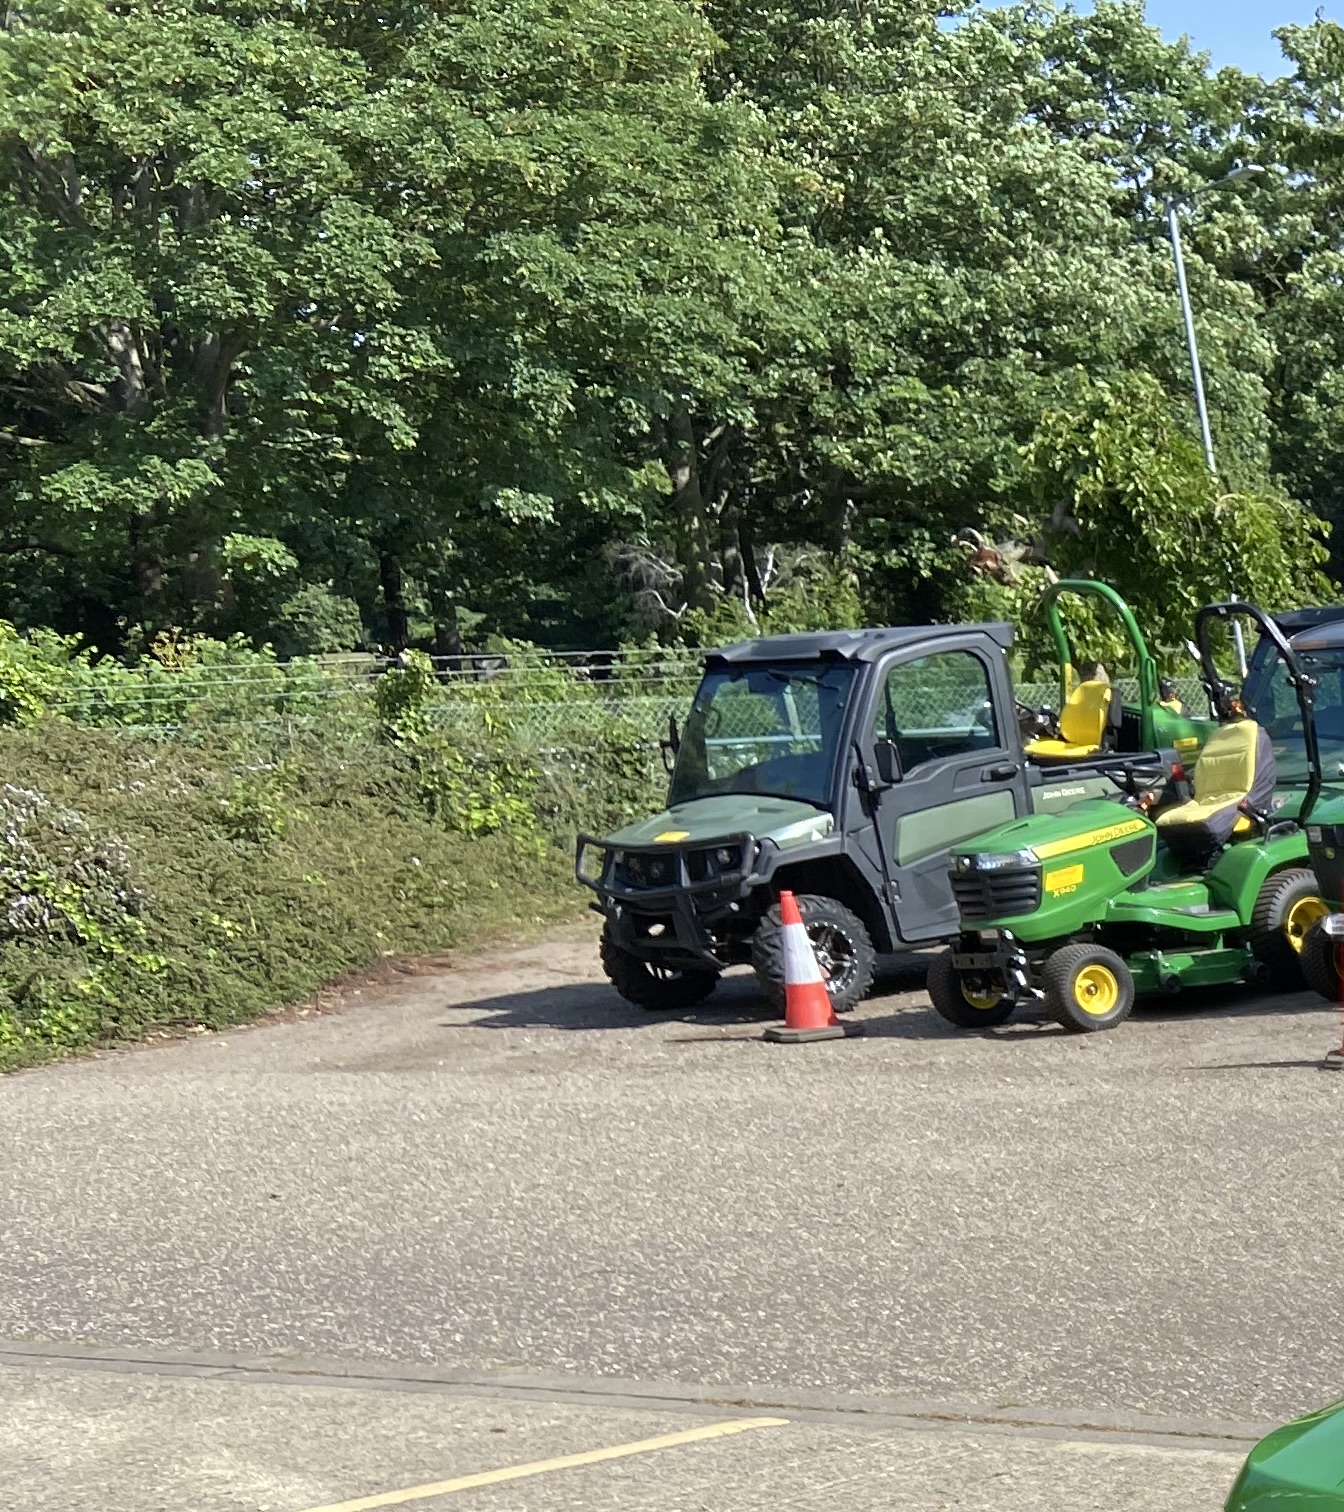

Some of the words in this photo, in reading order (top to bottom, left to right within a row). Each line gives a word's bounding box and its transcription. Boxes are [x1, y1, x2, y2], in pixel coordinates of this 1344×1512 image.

[1042, 790, 1061, 800] JOHN
[1061, 786, 1086, 797] DEERE
[1092, 830, 1113, 844] JOHN
[1113, 823, 1138, 838] DEERE
